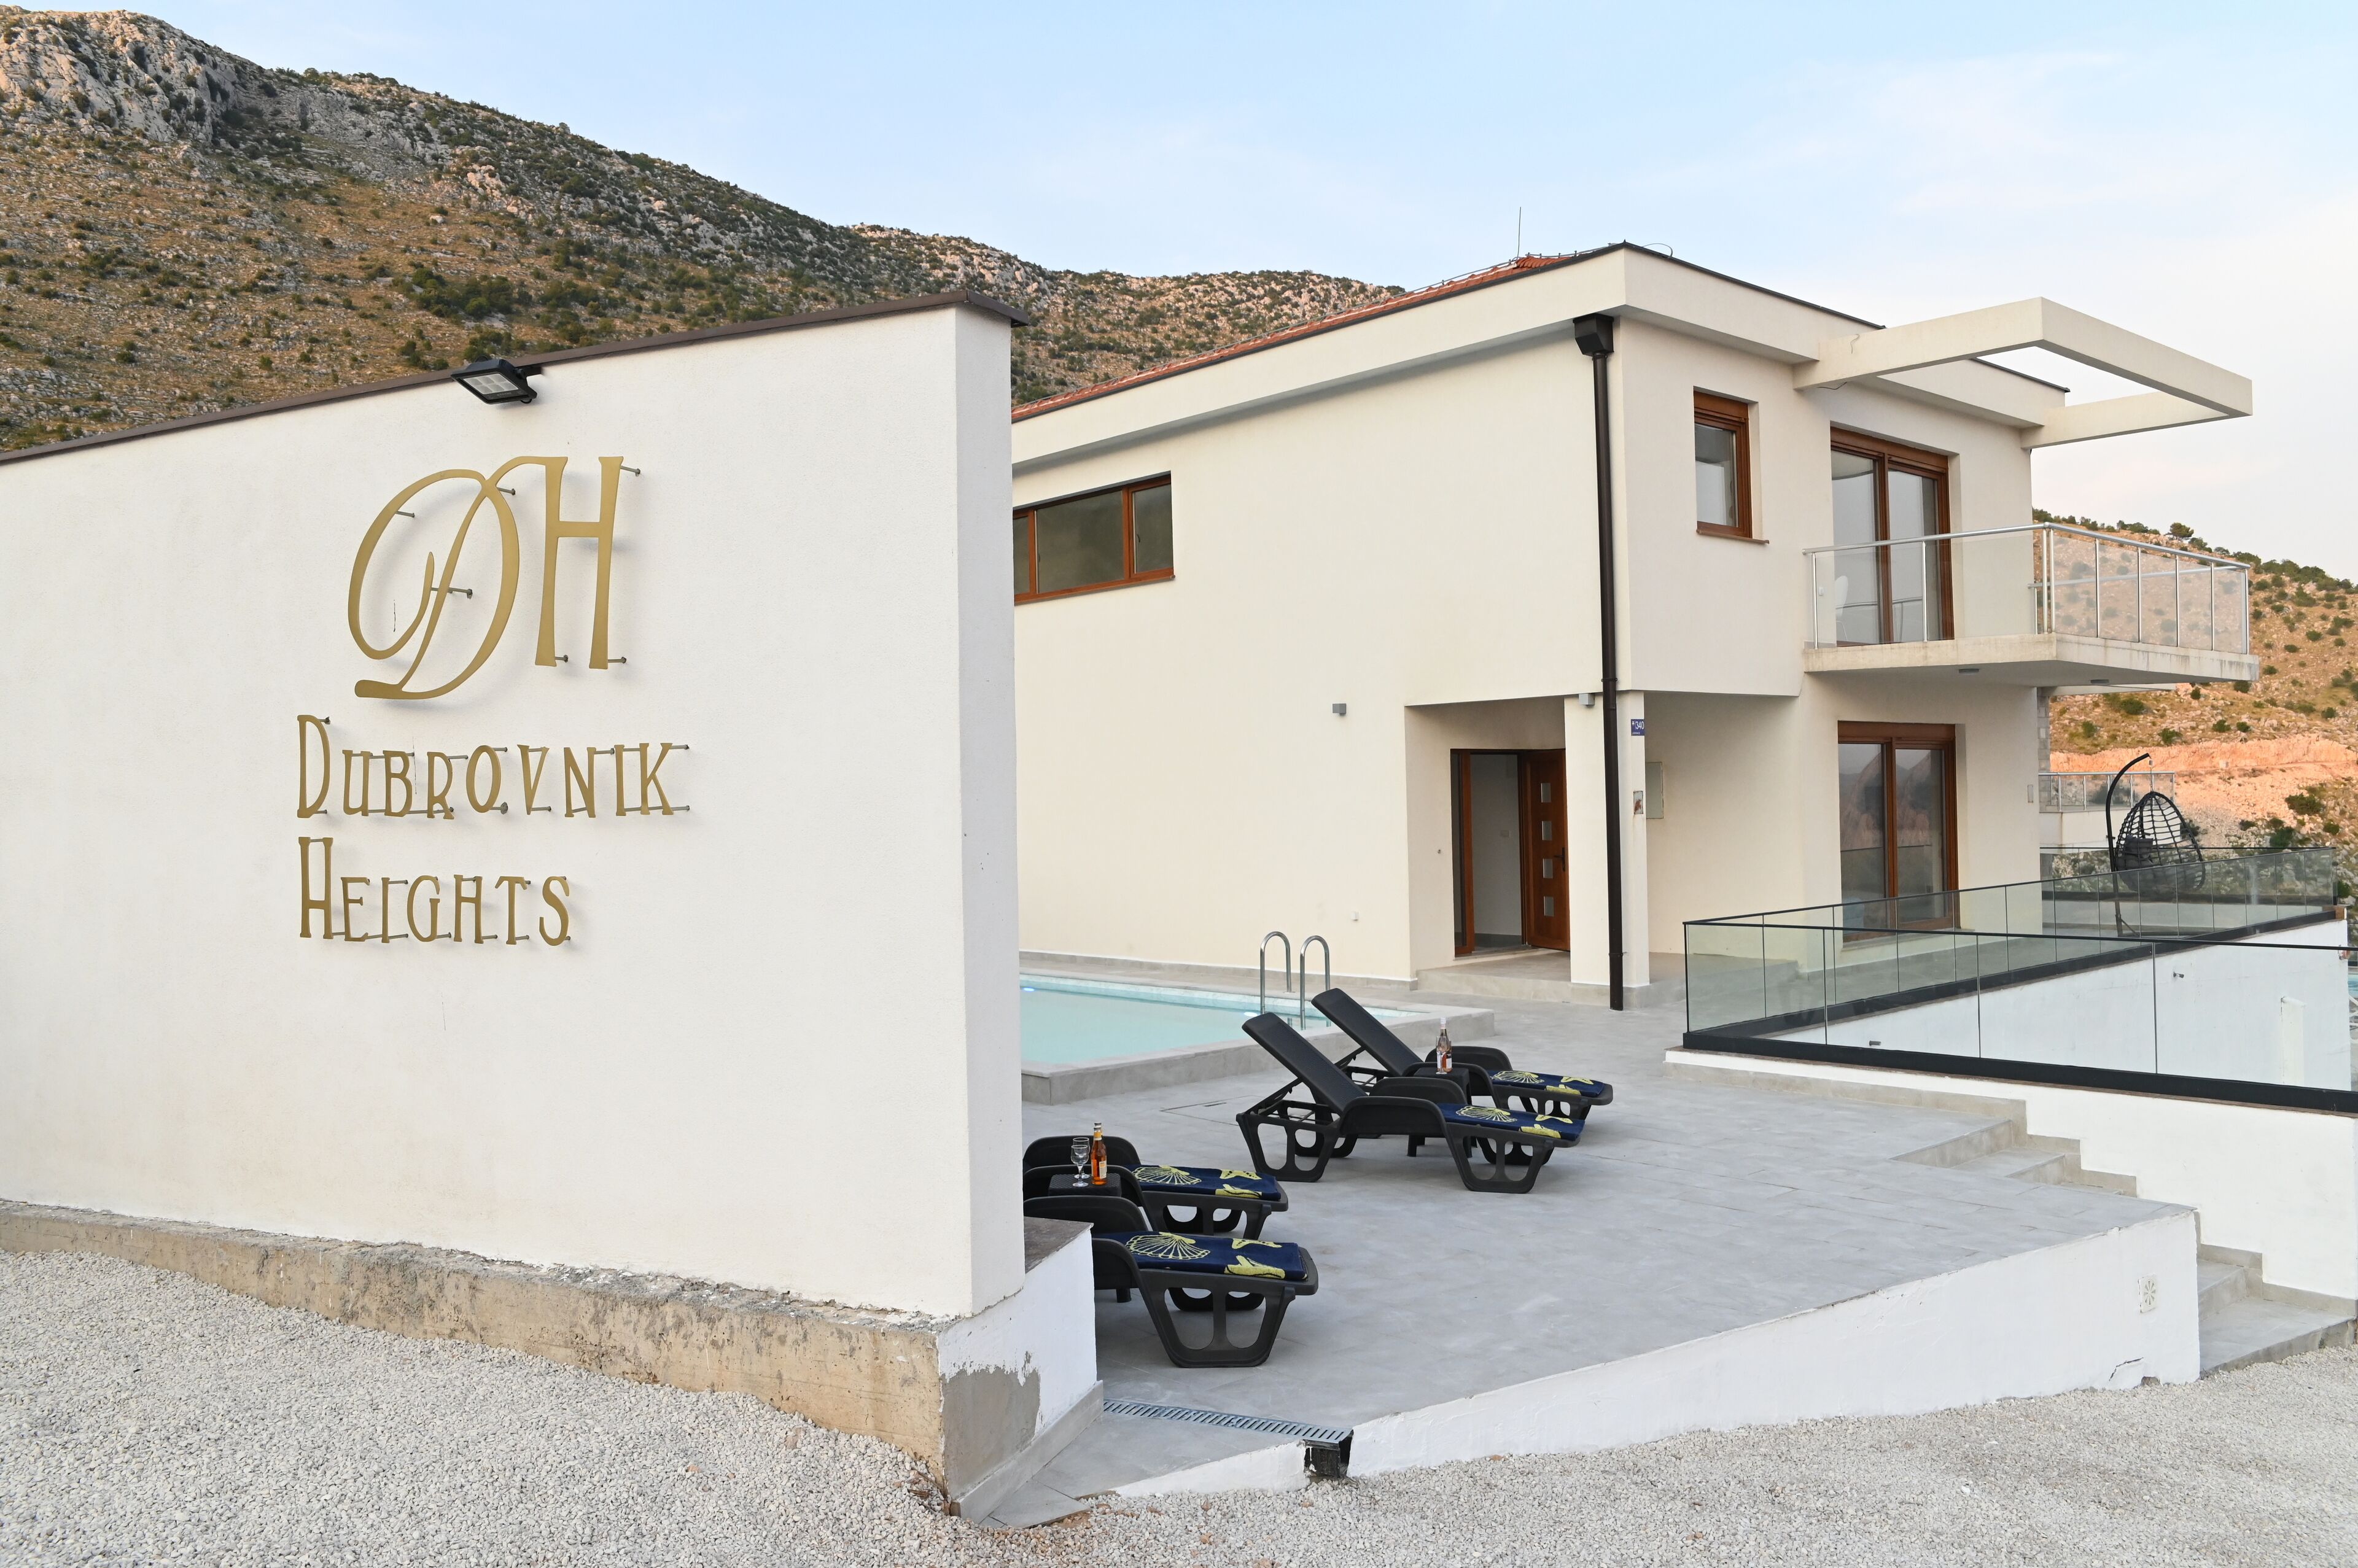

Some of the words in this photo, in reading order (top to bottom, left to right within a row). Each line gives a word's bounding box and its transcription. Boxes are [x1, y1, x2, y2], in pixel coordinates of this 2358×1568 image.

[348, 456, 624, 700] DH
[297, 715, 673, 819] DUBROVNIK
[1635, 721, 1644, 730] 340
[298, 837, 570, 946] HEIGHTS
